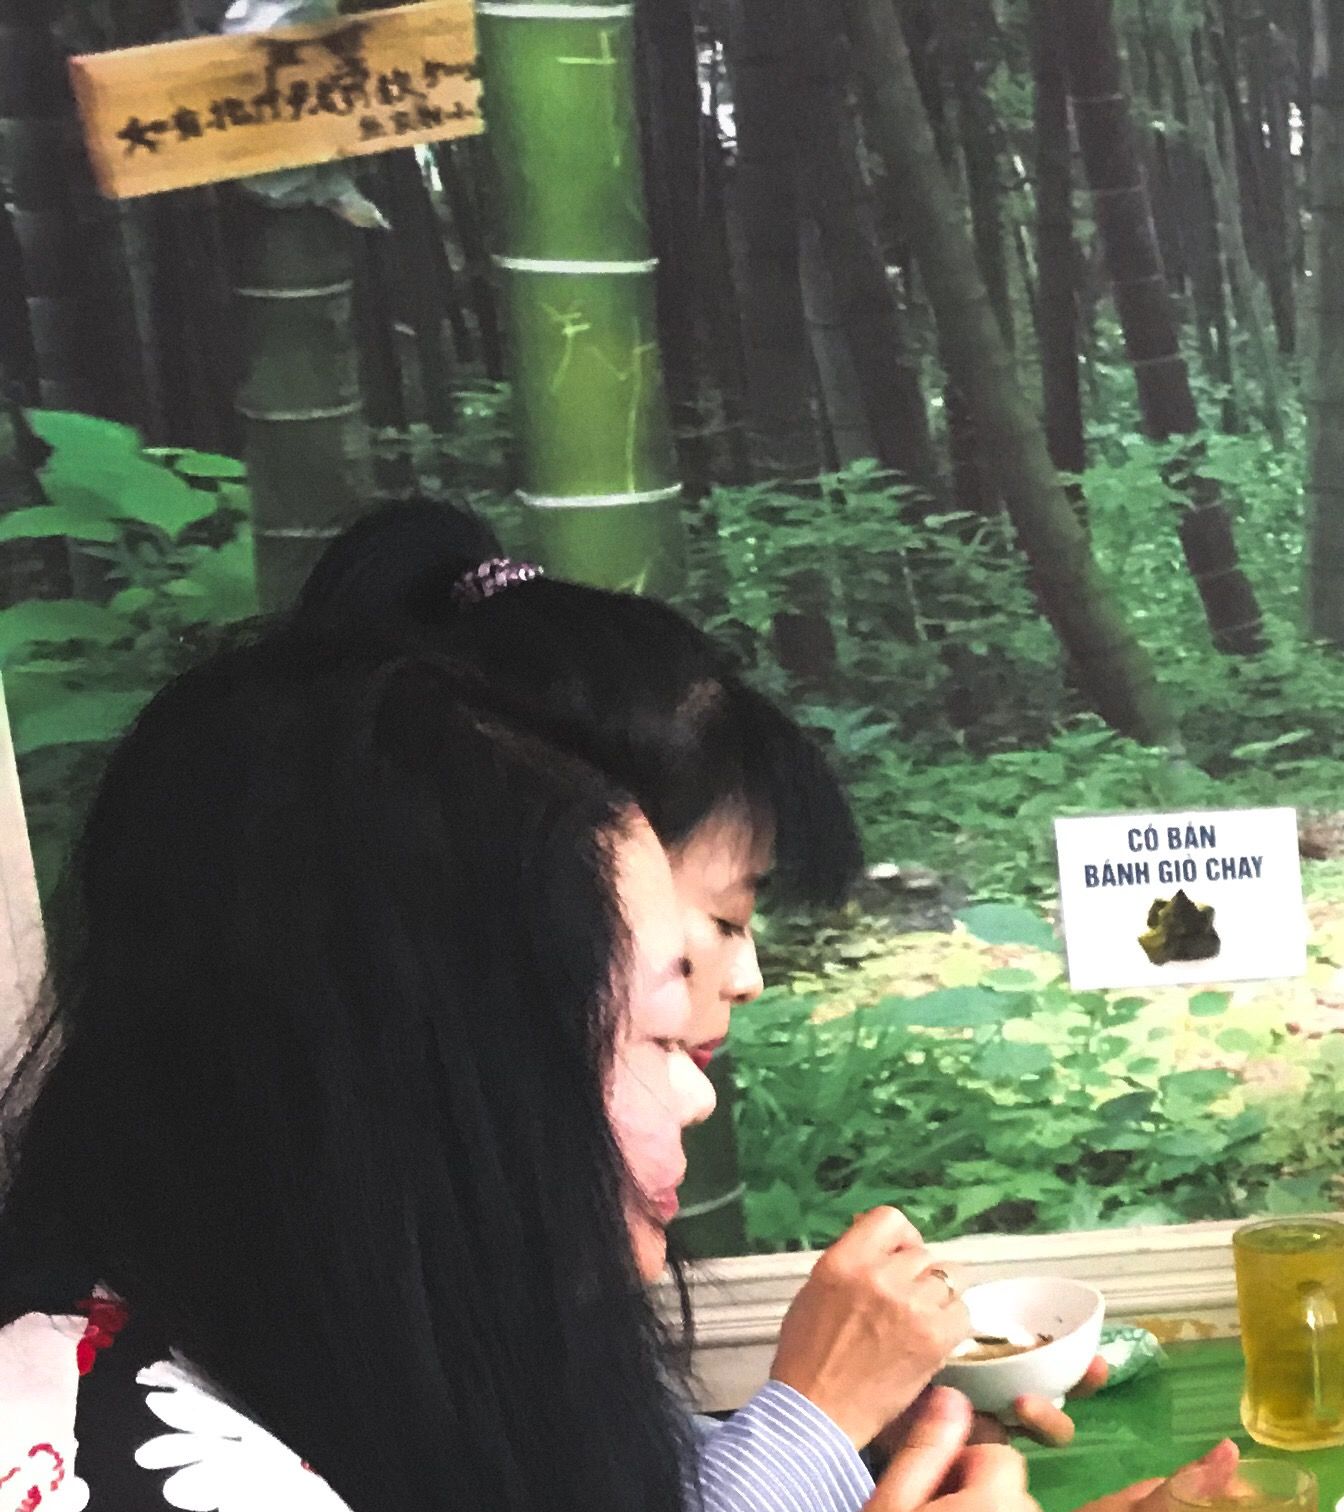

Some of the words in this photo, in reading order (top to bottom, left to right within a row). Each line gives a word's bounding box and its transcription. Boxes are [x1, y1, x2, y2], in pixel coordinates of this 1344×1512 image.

[1128, 824, 1159, 852] CÓ
[1167, 822, 1217, 850] BÁN
[1084, 859, 1150, 888] BÁNH
[1158, 855, 1198, 884] GIÒ
[1205, 855, 1264, 881] CHAY
